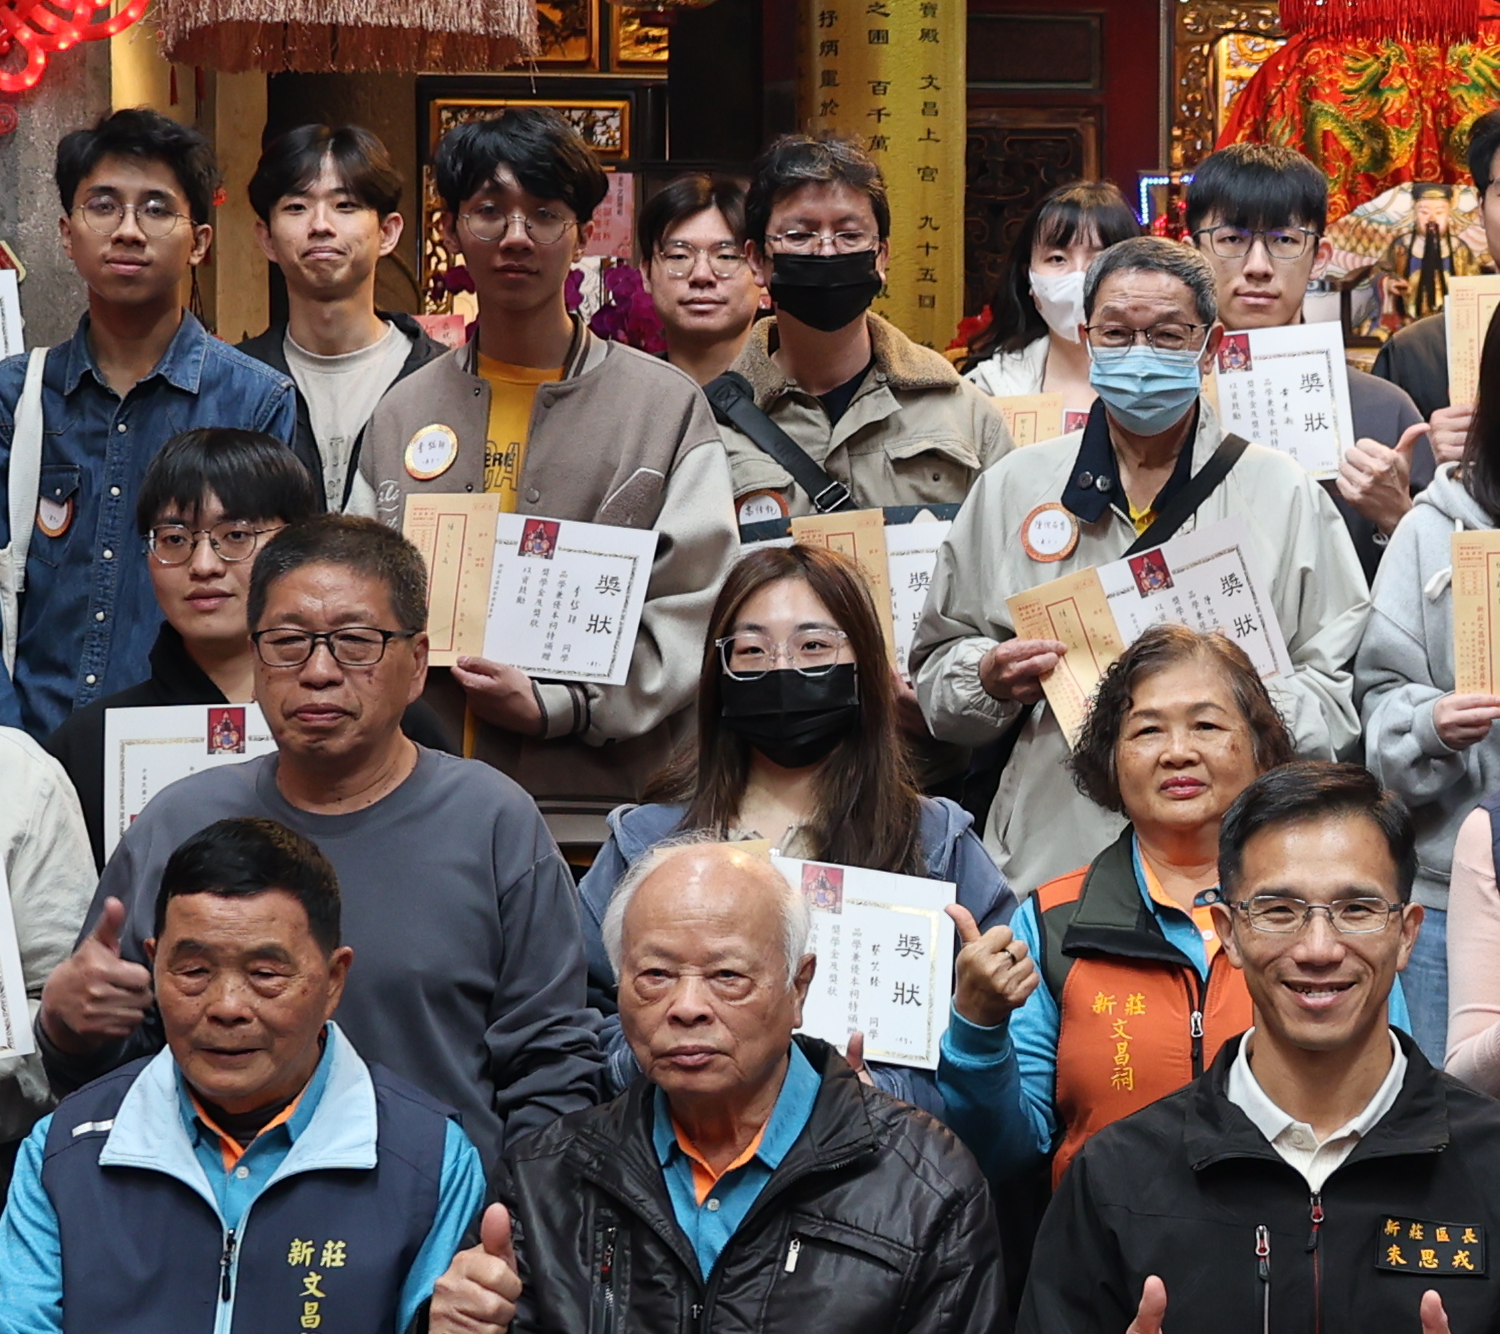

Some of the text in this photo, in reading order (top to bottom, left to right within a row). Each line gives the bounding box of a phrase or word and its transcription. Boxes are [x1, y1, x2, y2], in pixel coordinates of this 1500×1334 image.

[1300, 373, 1329, 432] 獎狀
[585, 574, 622, 635] 獎狀
[1220, 572, 1259, 639] 獎狀
[891, 933, 925, 1007] 獎狀
[1091, 991, 1147, 1016] 新莊
[1110, 1018, 1134, 1091] 文昌祠
[287, 1238, 348, 1268] 新莊
[1384, 1218, 1478, 1245] 新莊區長
[1386, 1244, 1475, 1271] 朱思戎
